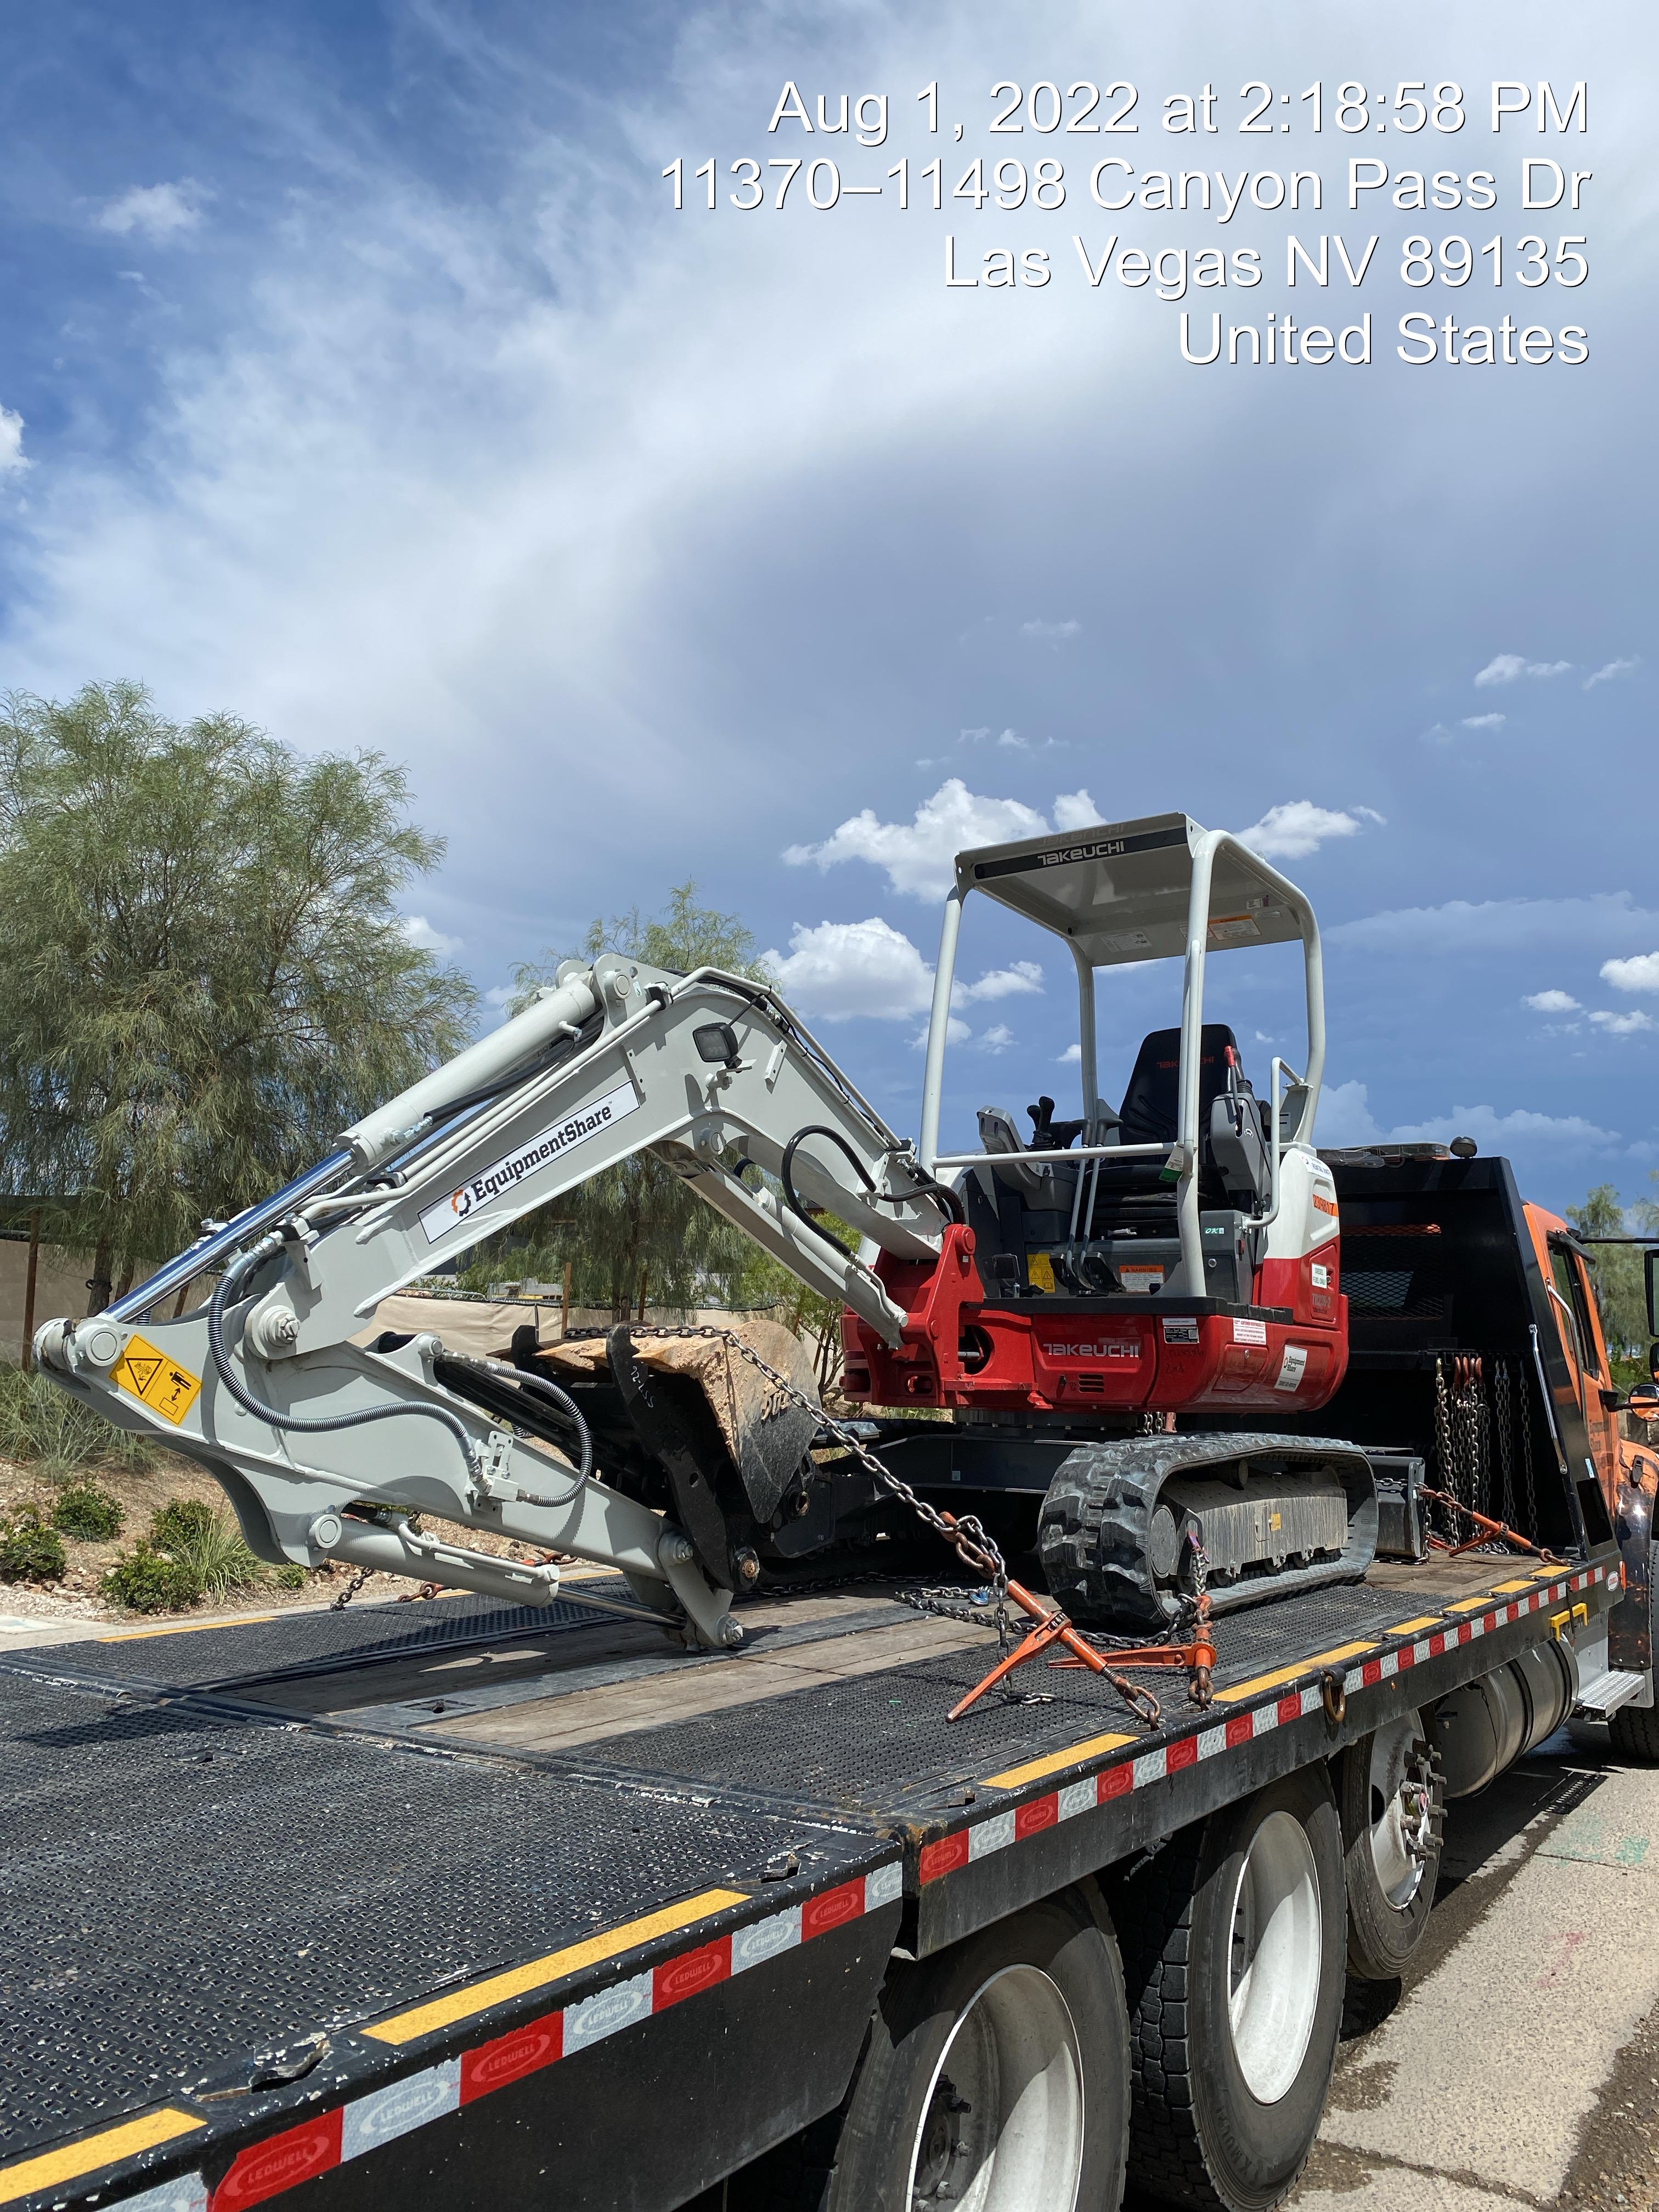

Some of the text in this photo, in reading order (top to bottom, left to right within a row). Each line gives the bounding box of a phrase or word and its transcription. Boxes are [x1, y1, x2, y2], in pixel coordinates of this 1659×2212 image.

[471, 1104, 612, 1203] EquipmentShare
[819, 1899, 849, 1918] LEDWELL
[752, 1928, 785, 1949] LEDWELL
[675, 1961, 712, 1985] LEDWELL
[588, 2002, 628, 2026] LEDWELL
[488, 2044, 535, 2072] LEDWELL
[380, 2090, 433, 2120] LEDWELL
[248, 2148, 309, 2185] LEDWELL
